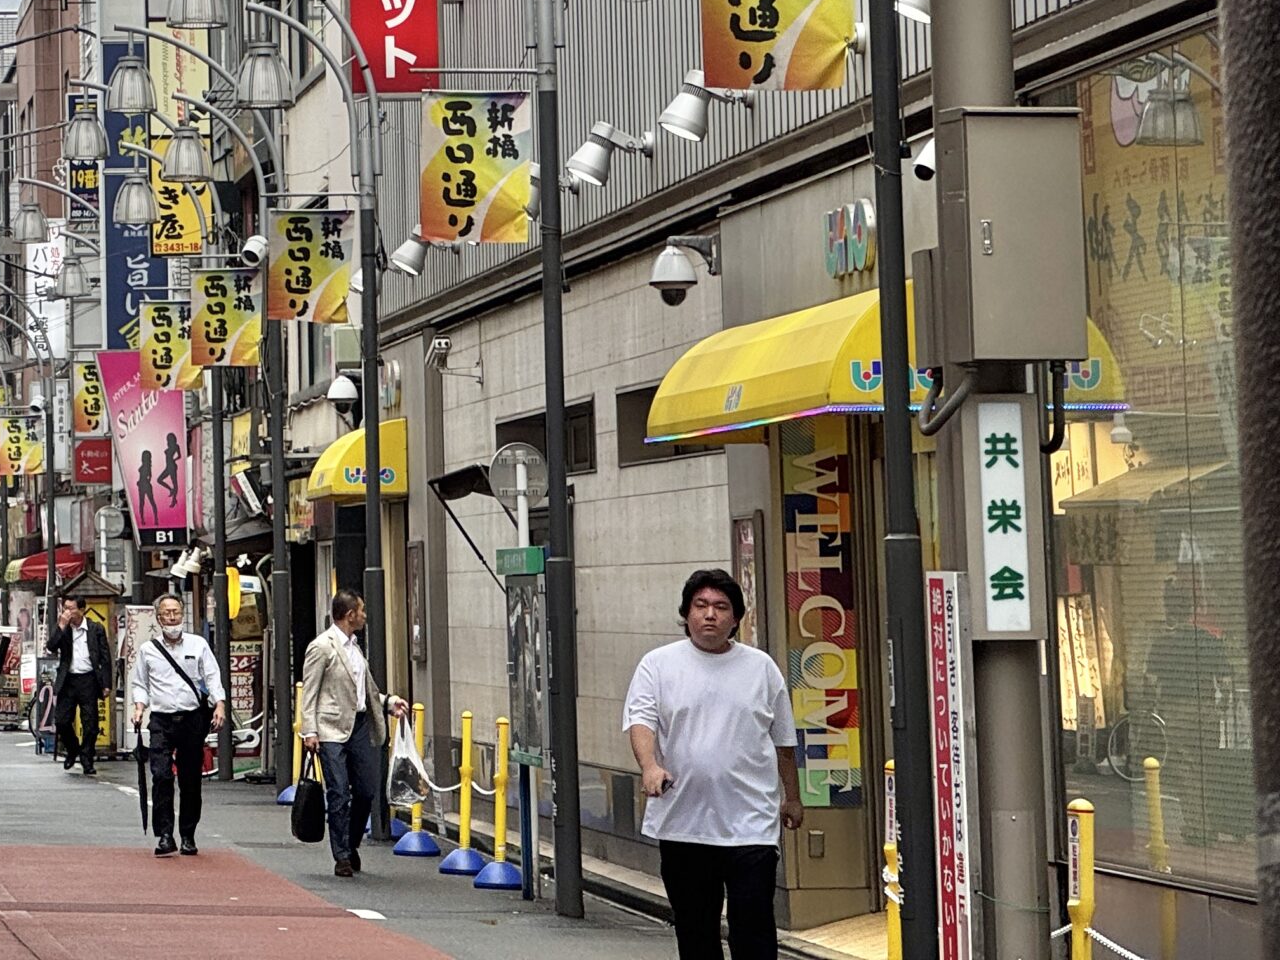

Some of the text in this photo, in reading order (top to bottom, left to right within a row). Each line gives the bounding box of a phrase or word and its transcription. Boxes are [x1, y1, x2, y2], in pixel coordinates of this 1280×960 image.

[442, 101, 478, 236] 西口通り
[485, 101, 519, 159] 新橋
[284, 217, 312, 317] 西口通り
[319, 217, 344, 261] 新橋
[204, 275, 228, 362] 西口通り
[233, 275, 255, 313] 新橋
[151, 306, 174, 388] 西口通り
[156, 531, 174, 543] B1
[984, 432, 1025, 601] 共栄会
[792, 448, 852, 796] WELCOME
